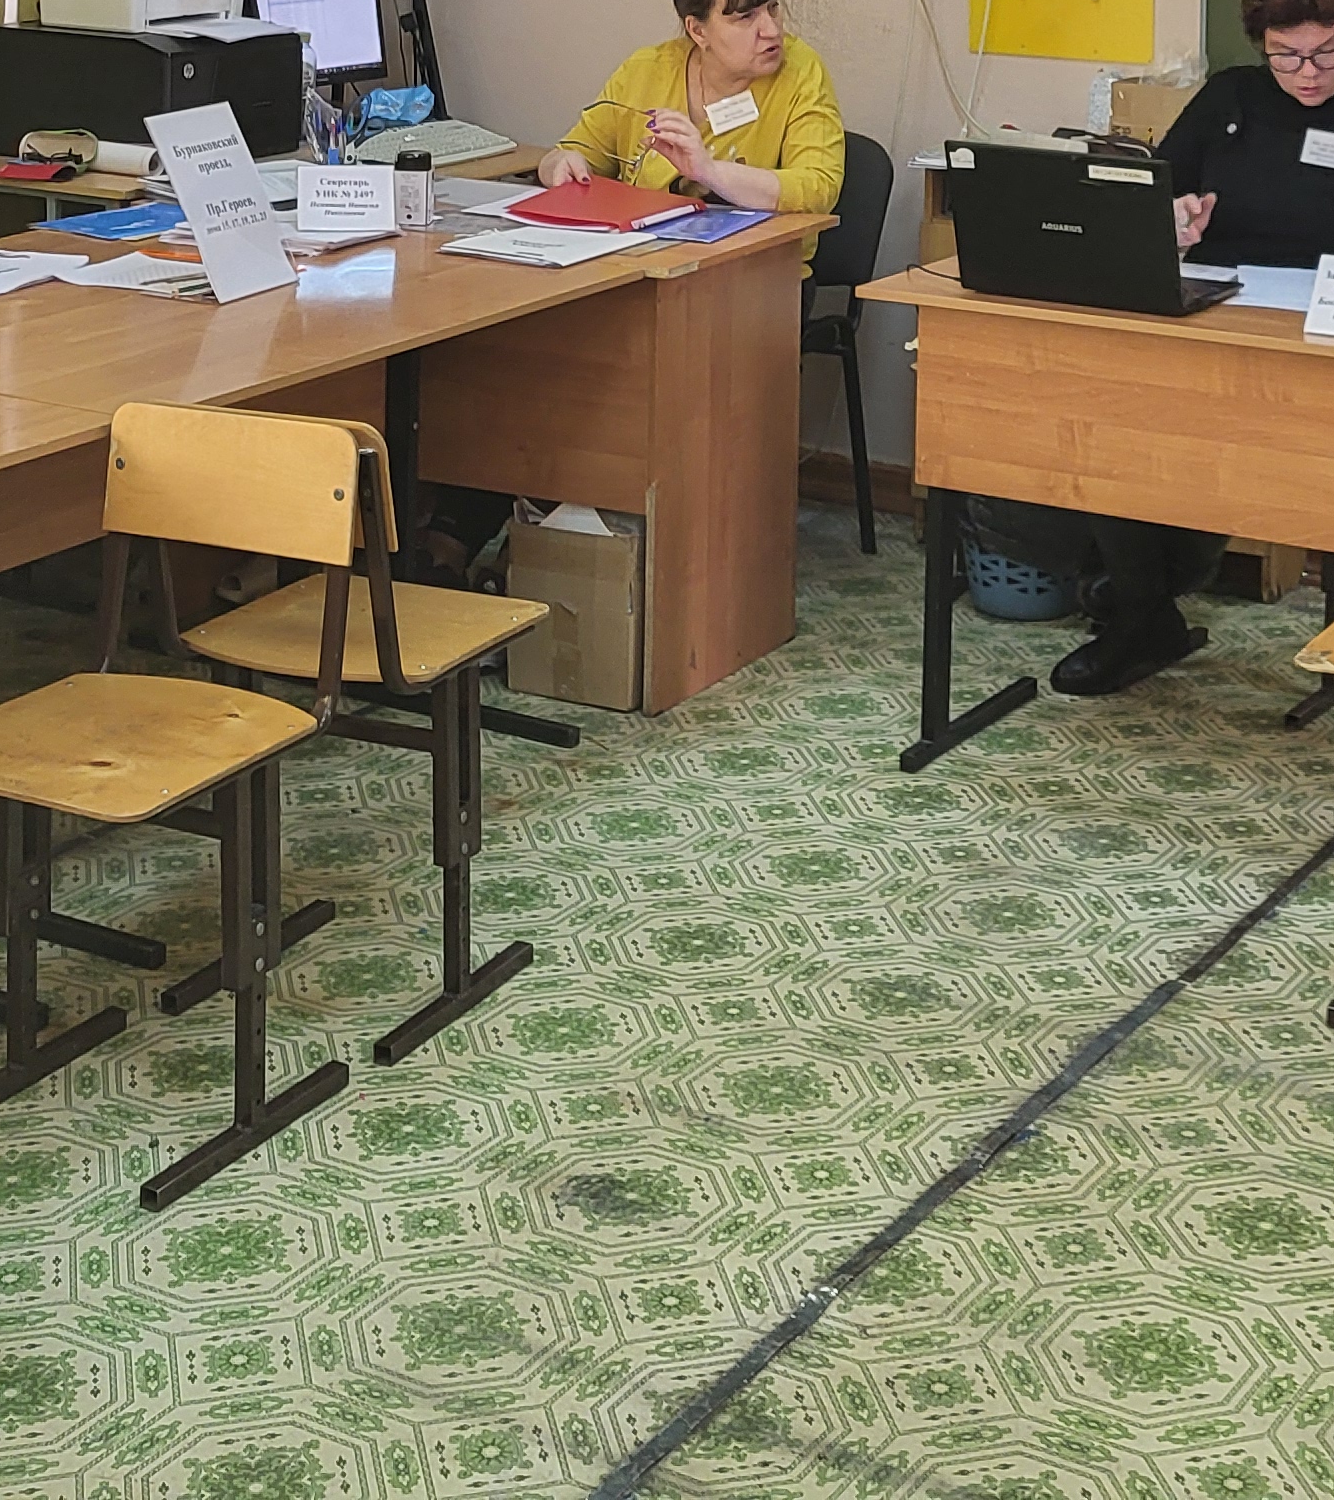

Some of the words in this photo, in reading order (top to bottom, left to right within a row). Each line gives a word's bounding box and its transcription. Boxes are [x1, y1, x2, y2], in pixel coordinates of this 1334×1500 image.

[172, 134, 240, 160] Бурнаковский
[197, 158, 233, 176] проезд,
[319, 177, 370, 188] Секретарь
[315, 189, 338, 198] УИК
[353, 190, 375, 199] 2497
[205, 197, 257, 218] Пр.Героев,
[1041, 221, 1083, 234] AQUARIUS
